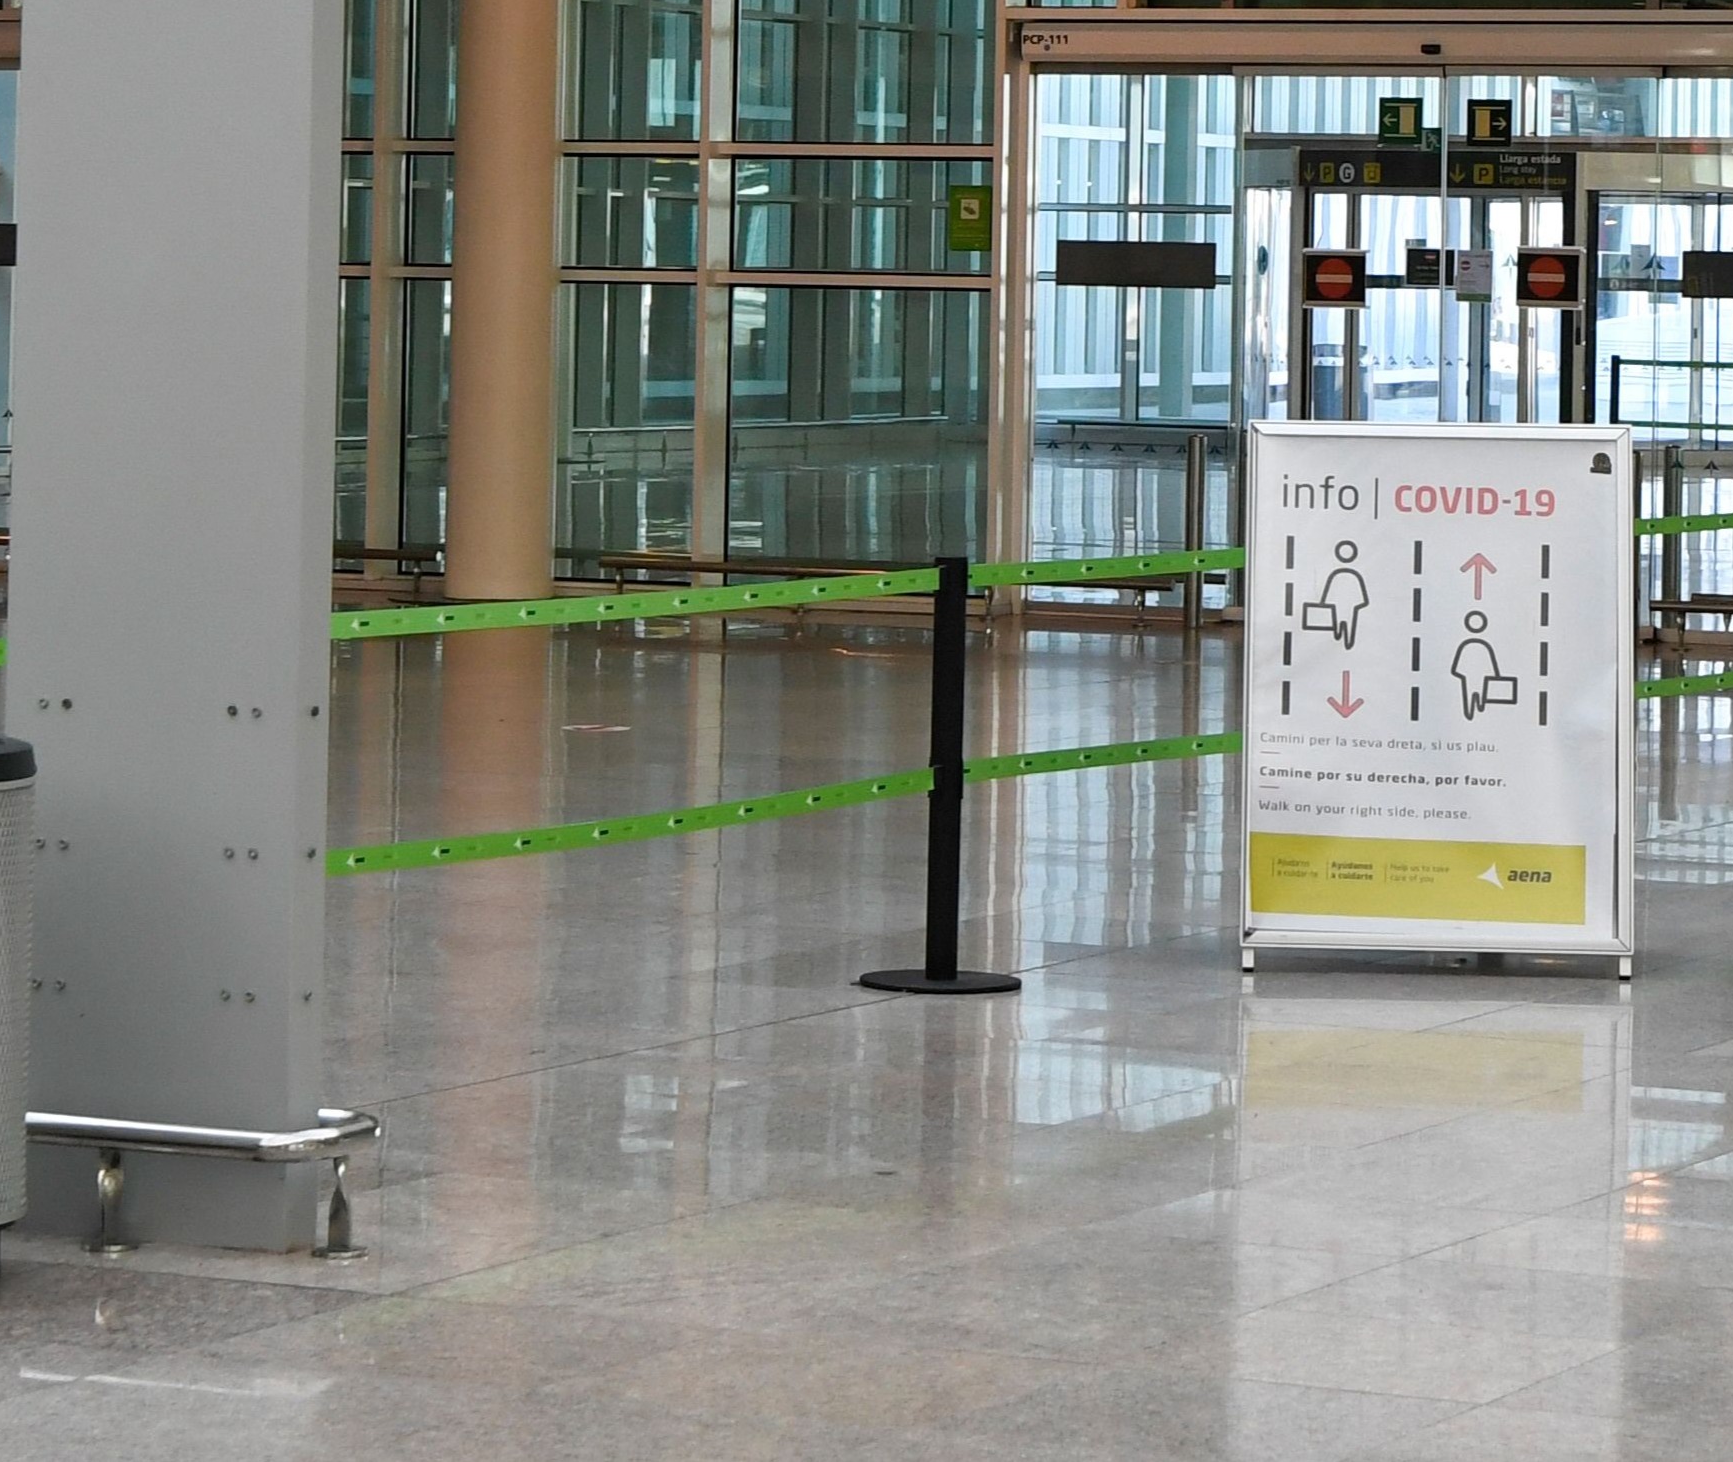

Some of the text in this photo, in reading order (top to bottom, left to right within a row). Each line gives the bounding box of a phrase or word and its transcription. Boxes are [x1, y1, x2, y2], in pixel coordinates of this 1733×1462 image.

[1022, 34, 1069, 46] PCP-111
[1530, 153, 1562, 165] estada
[1282, 473, 1557, 518] info COVID-19
[1309, 736, 1331, 747] per
[1335, 735, 1348, 747] la
[1352, 739, 1383, 749] seva
[1446, 741, 1463, 752] us
[1259, 766, 1507, 788] Camine por su derecha, por favor.
[1258, 799, 1291, 813] Walk
[1294, 802, 1312, 813] on
[1316, 803, 1347, 816] your
[1350, 803, 1383, 818] right
[1506, 867, 1553, 884] aena
